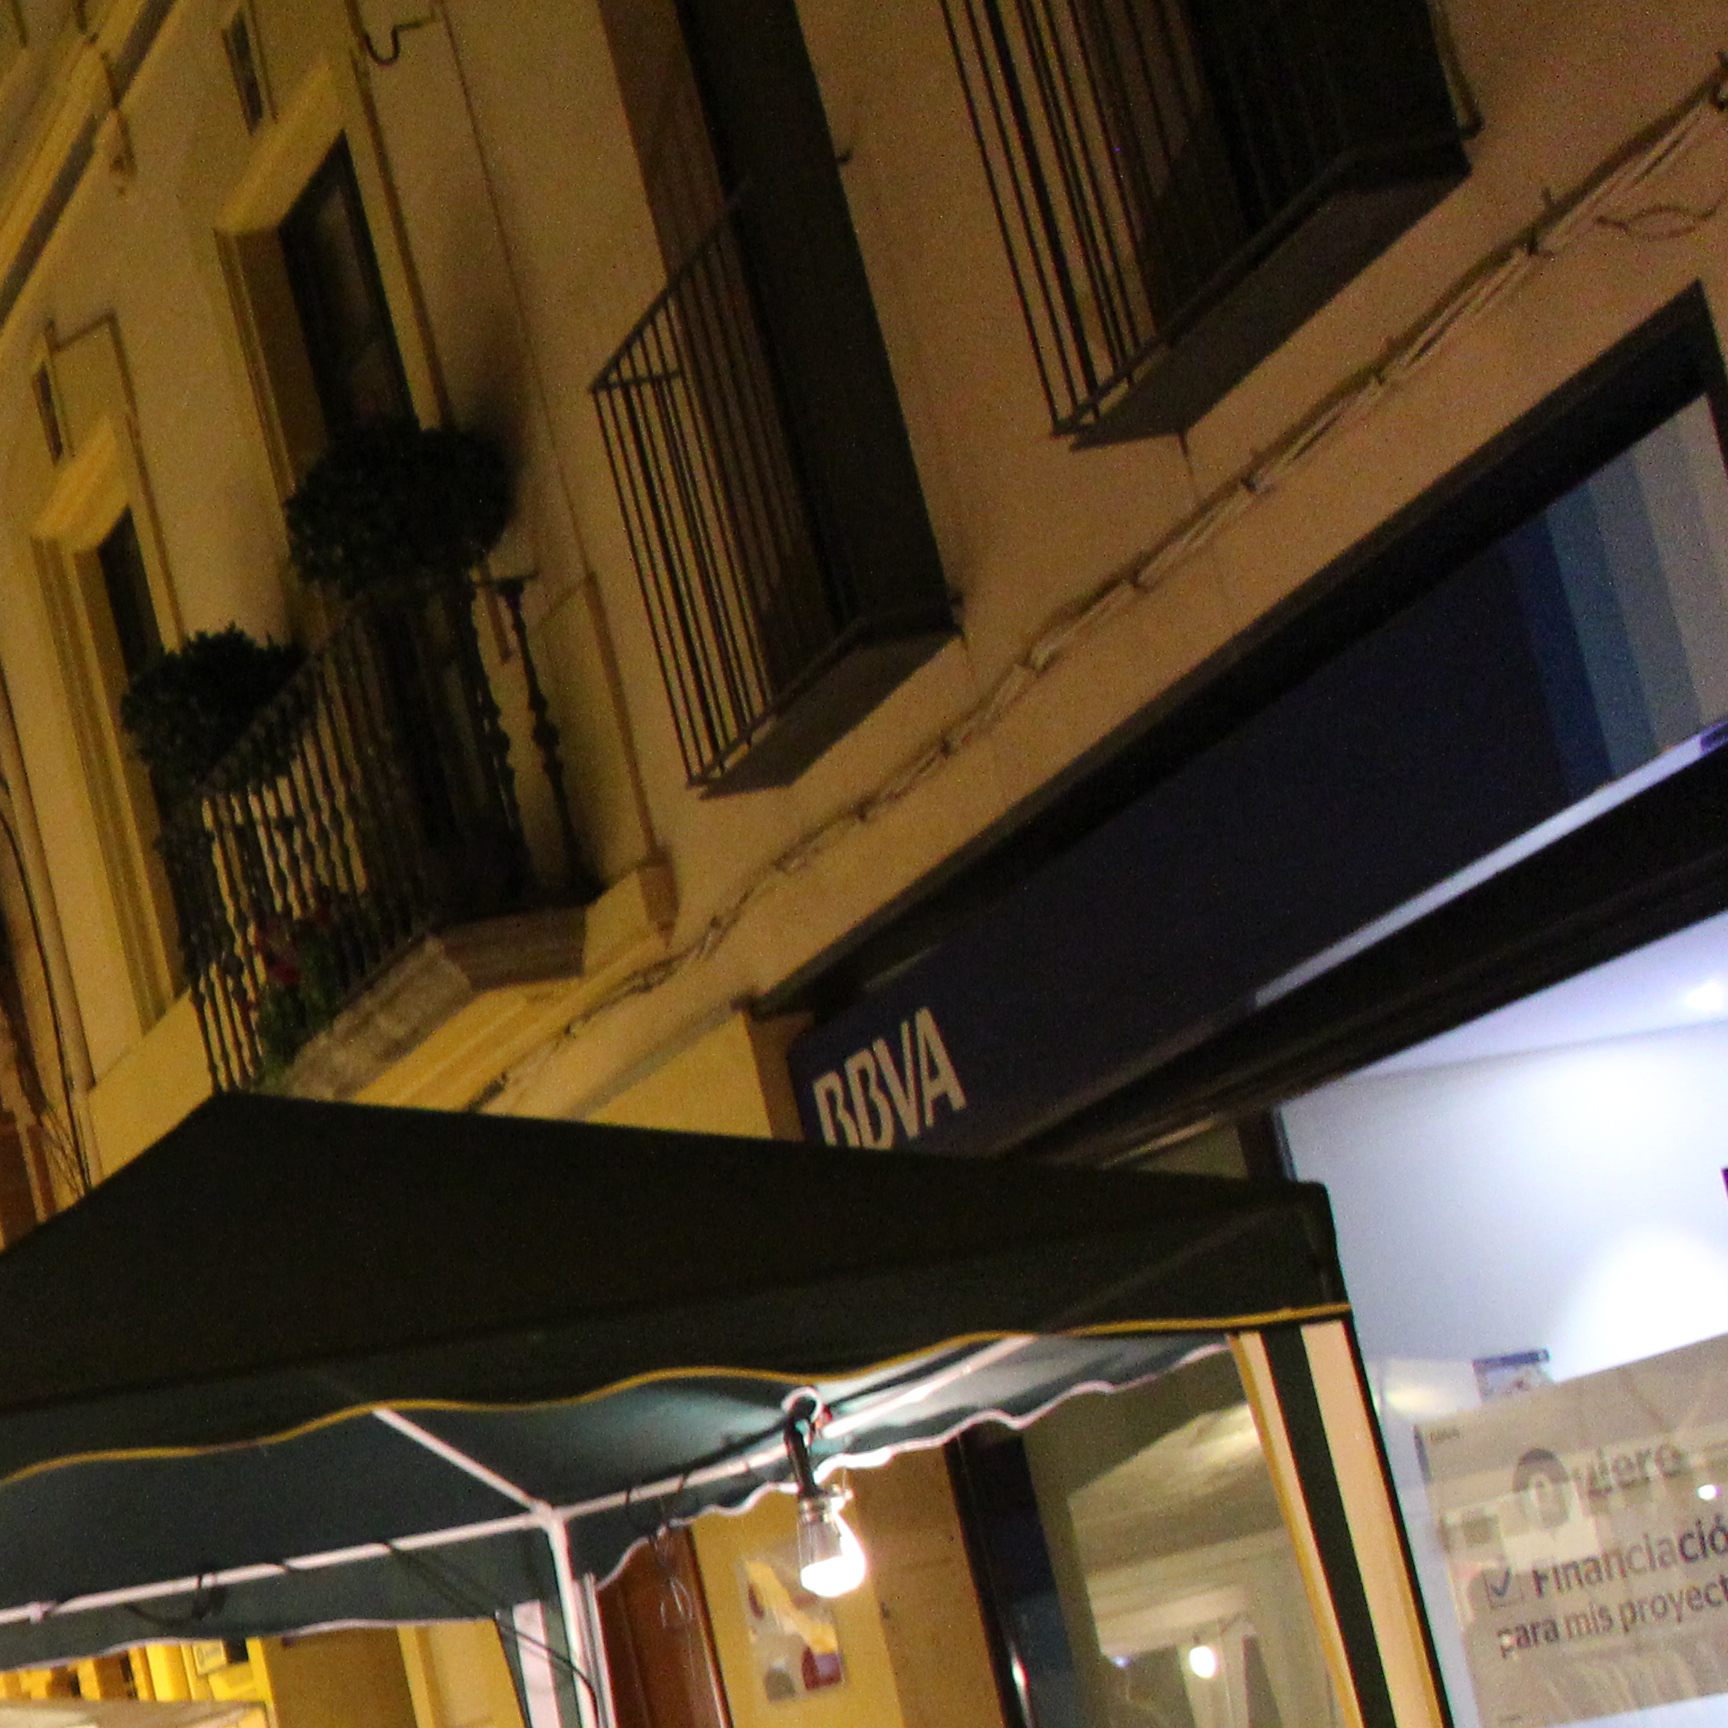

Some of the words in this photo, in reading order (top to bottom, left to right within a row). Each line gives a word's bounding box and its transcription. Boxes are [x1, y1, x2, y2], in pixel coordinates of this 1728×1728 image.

[812, 1006, 967, 1150] BBVA
[1496, 1617, 1560, 1658] para
[1563, 1602, 1613, 1639] mis
